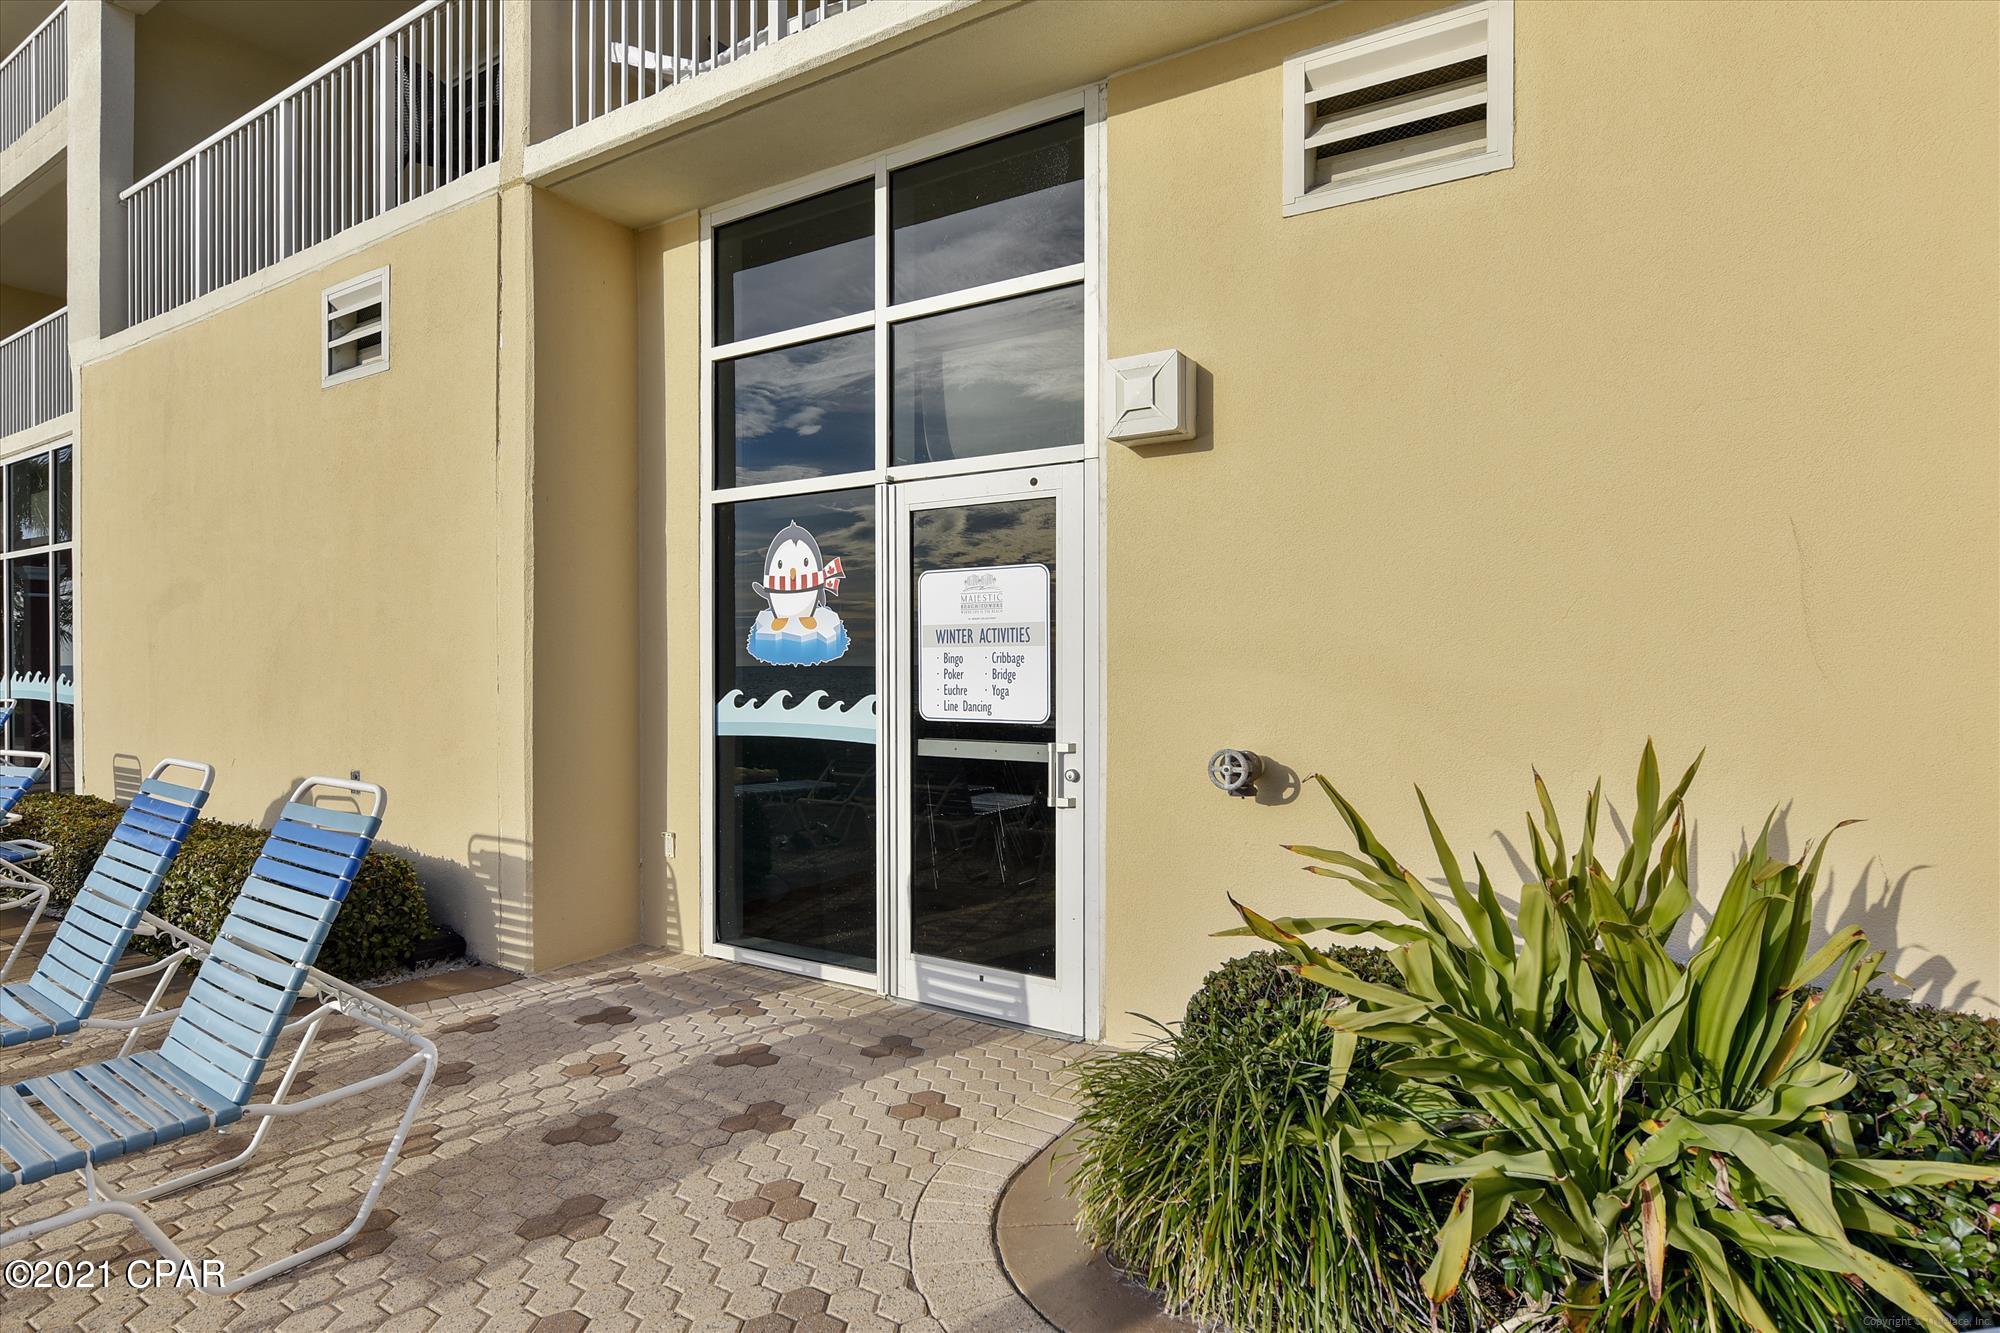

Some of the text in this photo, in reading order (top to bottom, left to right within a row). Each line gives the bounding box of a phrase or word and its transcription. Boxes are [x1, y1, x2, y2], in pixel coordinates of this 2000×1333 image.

[960, 594, 1003, 603] MAJESTIC
[935, 626, 1031, 644] WINTER ACTIVITIES
[943, 652, 964, 668] Bingo
[991, 651, 1025, 668] Cribbage
[943, 669, 964, 680] Poker
[992, 668, 1017, 683] Bridge
[943, 684, 968, 696] Euchre
[991, 684, 1010, 700] Yoga
[943, 700, 992, 716] Line Dancing
